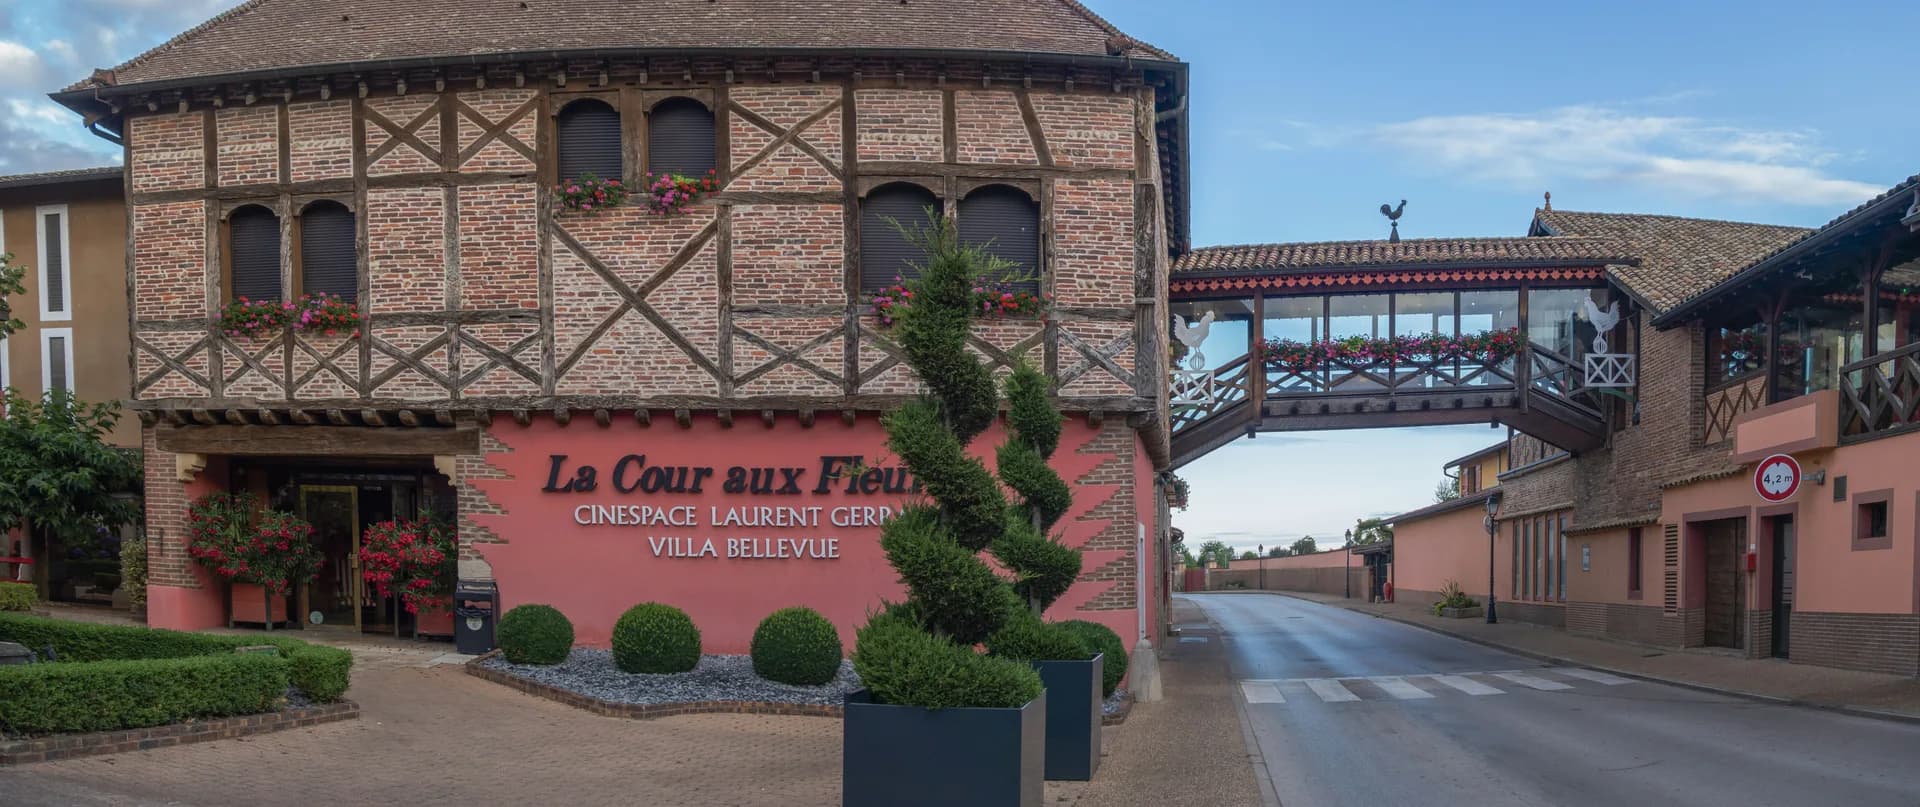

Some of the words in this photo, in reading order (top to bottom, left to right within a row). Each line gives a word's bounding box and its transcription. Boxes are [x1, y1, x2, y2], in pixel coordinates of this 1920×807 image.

[541, 454, 598, 493] La
[612, 454, 714, 494] Cour
[723, 466, 806, 494] aux
[1763, 473, 1782, 485] 4,2
[574, 504, 697, 526] CINESPACE
[711, 505, 823, 527] LAURENT
[830, 506, 905, 527] GERR
[648, 536, 718, 557] VILLA
[727, 538, 840, 559] BELLEVUE
